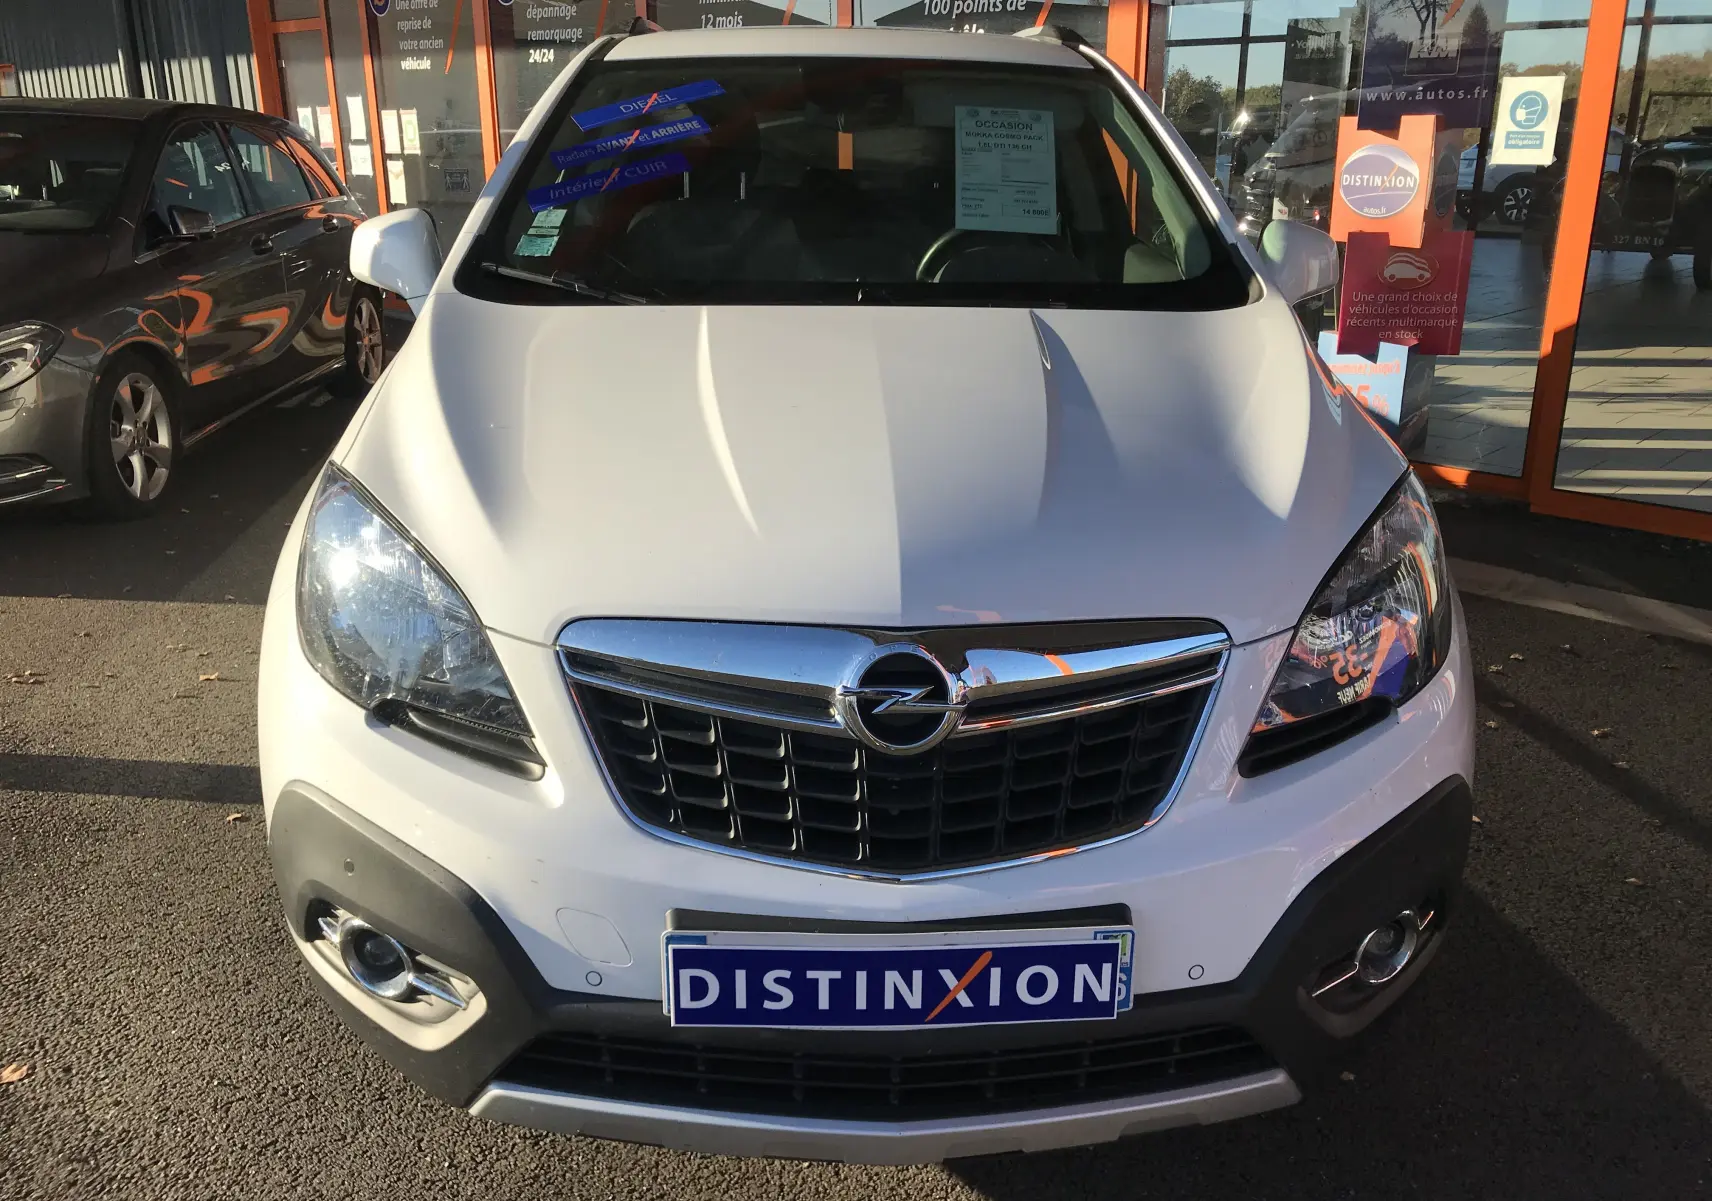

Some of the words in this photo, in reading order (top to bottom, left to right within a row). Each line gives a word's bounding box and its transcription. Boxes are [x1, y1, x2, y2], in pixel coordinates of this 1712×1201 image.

[395, 0, 409, 10] Une
[410, 0, 427, 9] offre
[429, 0, 438, 8] de
[924, 0, 950, 15] 100
[952, 0, 1002, 19] points
[1006, 0, 1026, 11] de
[526, 4, 577, 22] dépannage
[700, 13, 713, 29] 12
[715, 11, 743, 28] mois
[397, 17, 422, 33] reprise
[422, 16, 432, 29] de
[399, 38, 418, 50] votre
[419, 36, 444, 49] ancien
[527, 28, 583, 43] remorquage
[400, 55, 431, 70] véhicule
[528, 48, 555, 63] 24/24
[1366, 86, 1489, 101] www.autos.fr
[619, 92, 678, 114] DIESEL
[975, 119, 1033, 131] OCCASION
[556, 147, 595, 165] Radars
[638, 131, 650, 142] et
[651, 119, 701, 139] ARRIÈRE
[1507, 138, 1541, 146] obligatoire
[624, 160, 668, 179] CUIR
[1343, 170, 1415, 190] DISTINXION
[1363, 206, 1386, 215] autos.fr
[1352, 292, 1375, 302] Une
[1377, 292, 1410, 304] grand
[1412, 291, 1442, 302] choix
[1443, 291, 1458, 302] de
[1349, 304, 1400, 314] véhicules
[1402, 303, 1458, 314] d'occasion
[1346, 316, 1386, 327] récents
[1388, 316, 1458, 327] multimarque
[1378, 331, 1392, 339] en
[1395, 329, 1424, 339] stock
[868, 644, 935, 662] OPEL
[678, 951, 1113, 1022] DISTINXION
